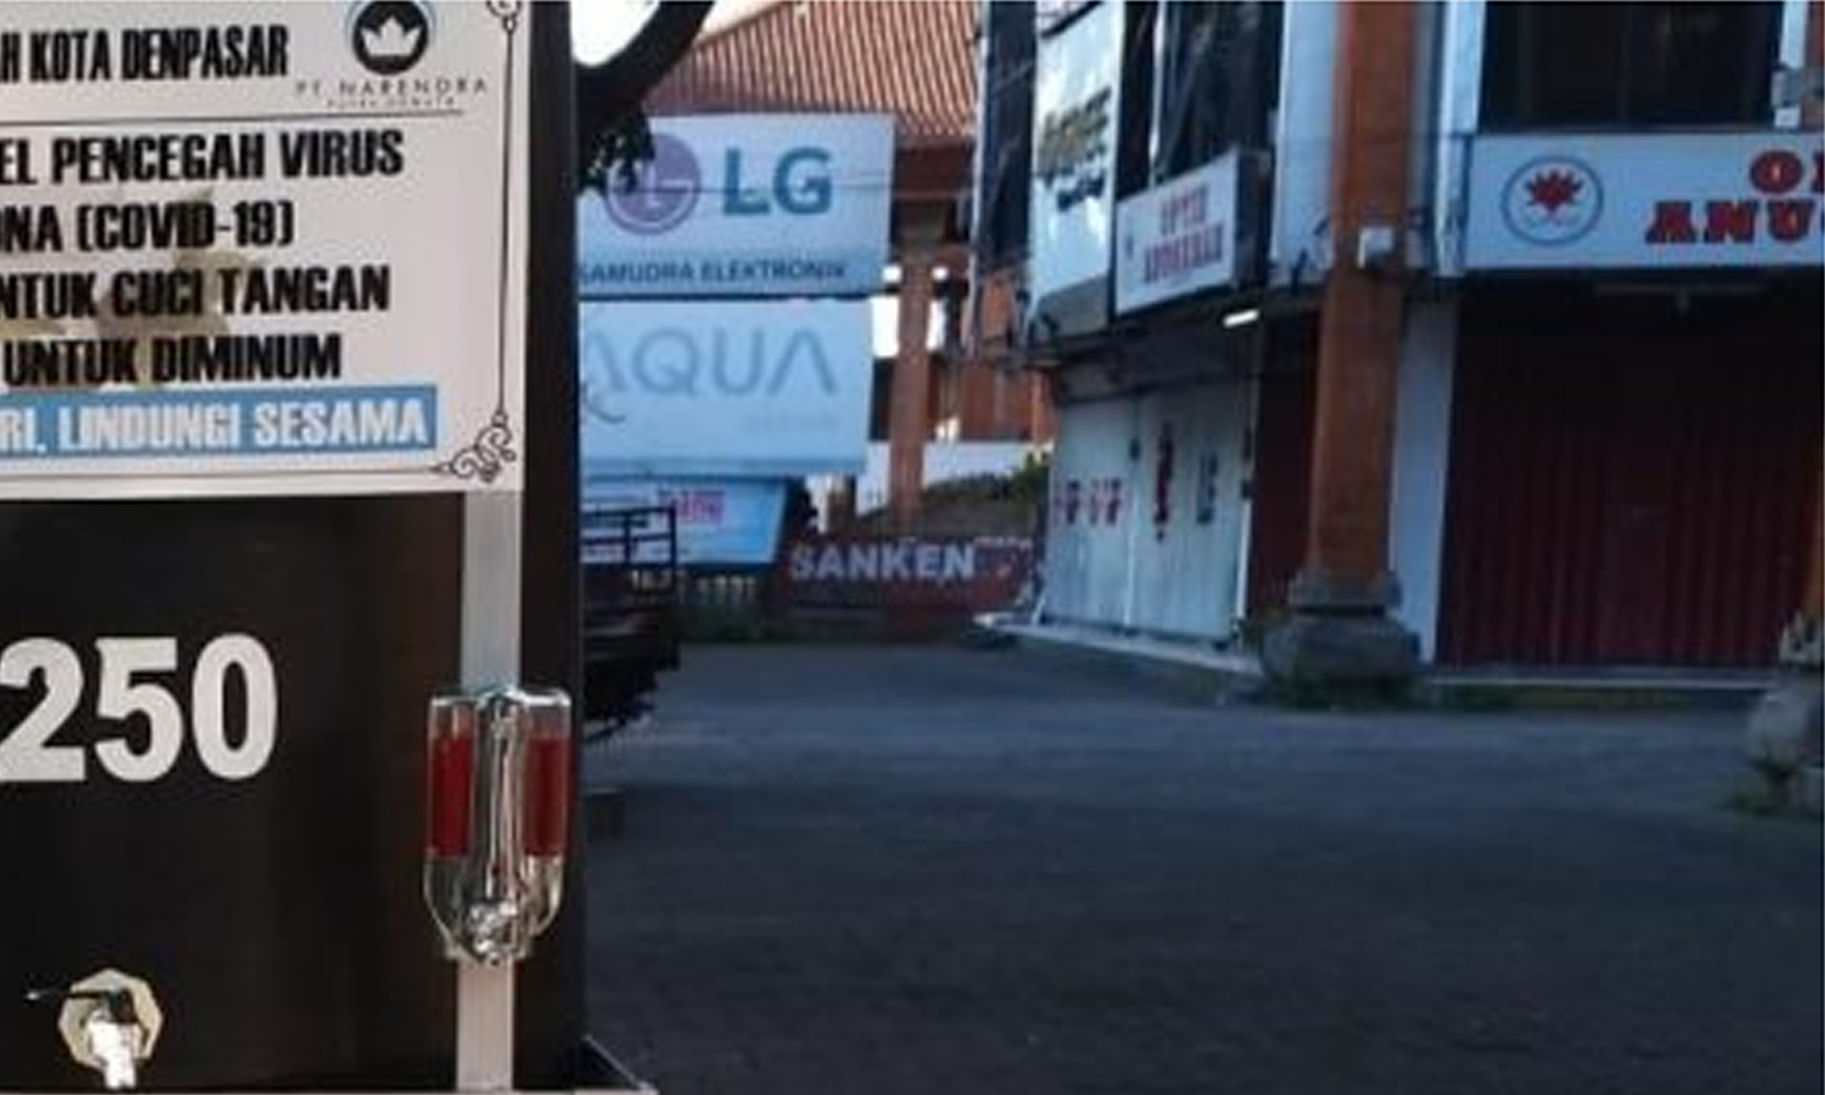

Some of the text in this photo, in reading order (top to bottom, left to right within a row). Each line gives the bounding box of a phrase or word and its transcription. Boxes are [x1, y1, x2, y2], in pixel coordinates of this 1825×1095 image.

[29, 29, 112, 82] KOTA
[121, 24, 289, 81] DENPASAR
[339, 77, 487, 96] NARENDRA
[52, 132, 265, 184] PENCEGAH
[279, 129, 404, 178] VIRUS
[721, 146, 835, 217] LG
[76, 200, 295, 253] (COVID-19)
[111, 268, 205, 318] CUCI
[217, 265, 390, 315] TANGAN
[3, 339, 137, 388] UNTUK
[150, 333, 342, 384] DIMINUM
[58, 402, 242, 452] LINDUNGI
[253, 398, 428, 447] SESAMA
[792, 540, 974, 582] SANKEN
